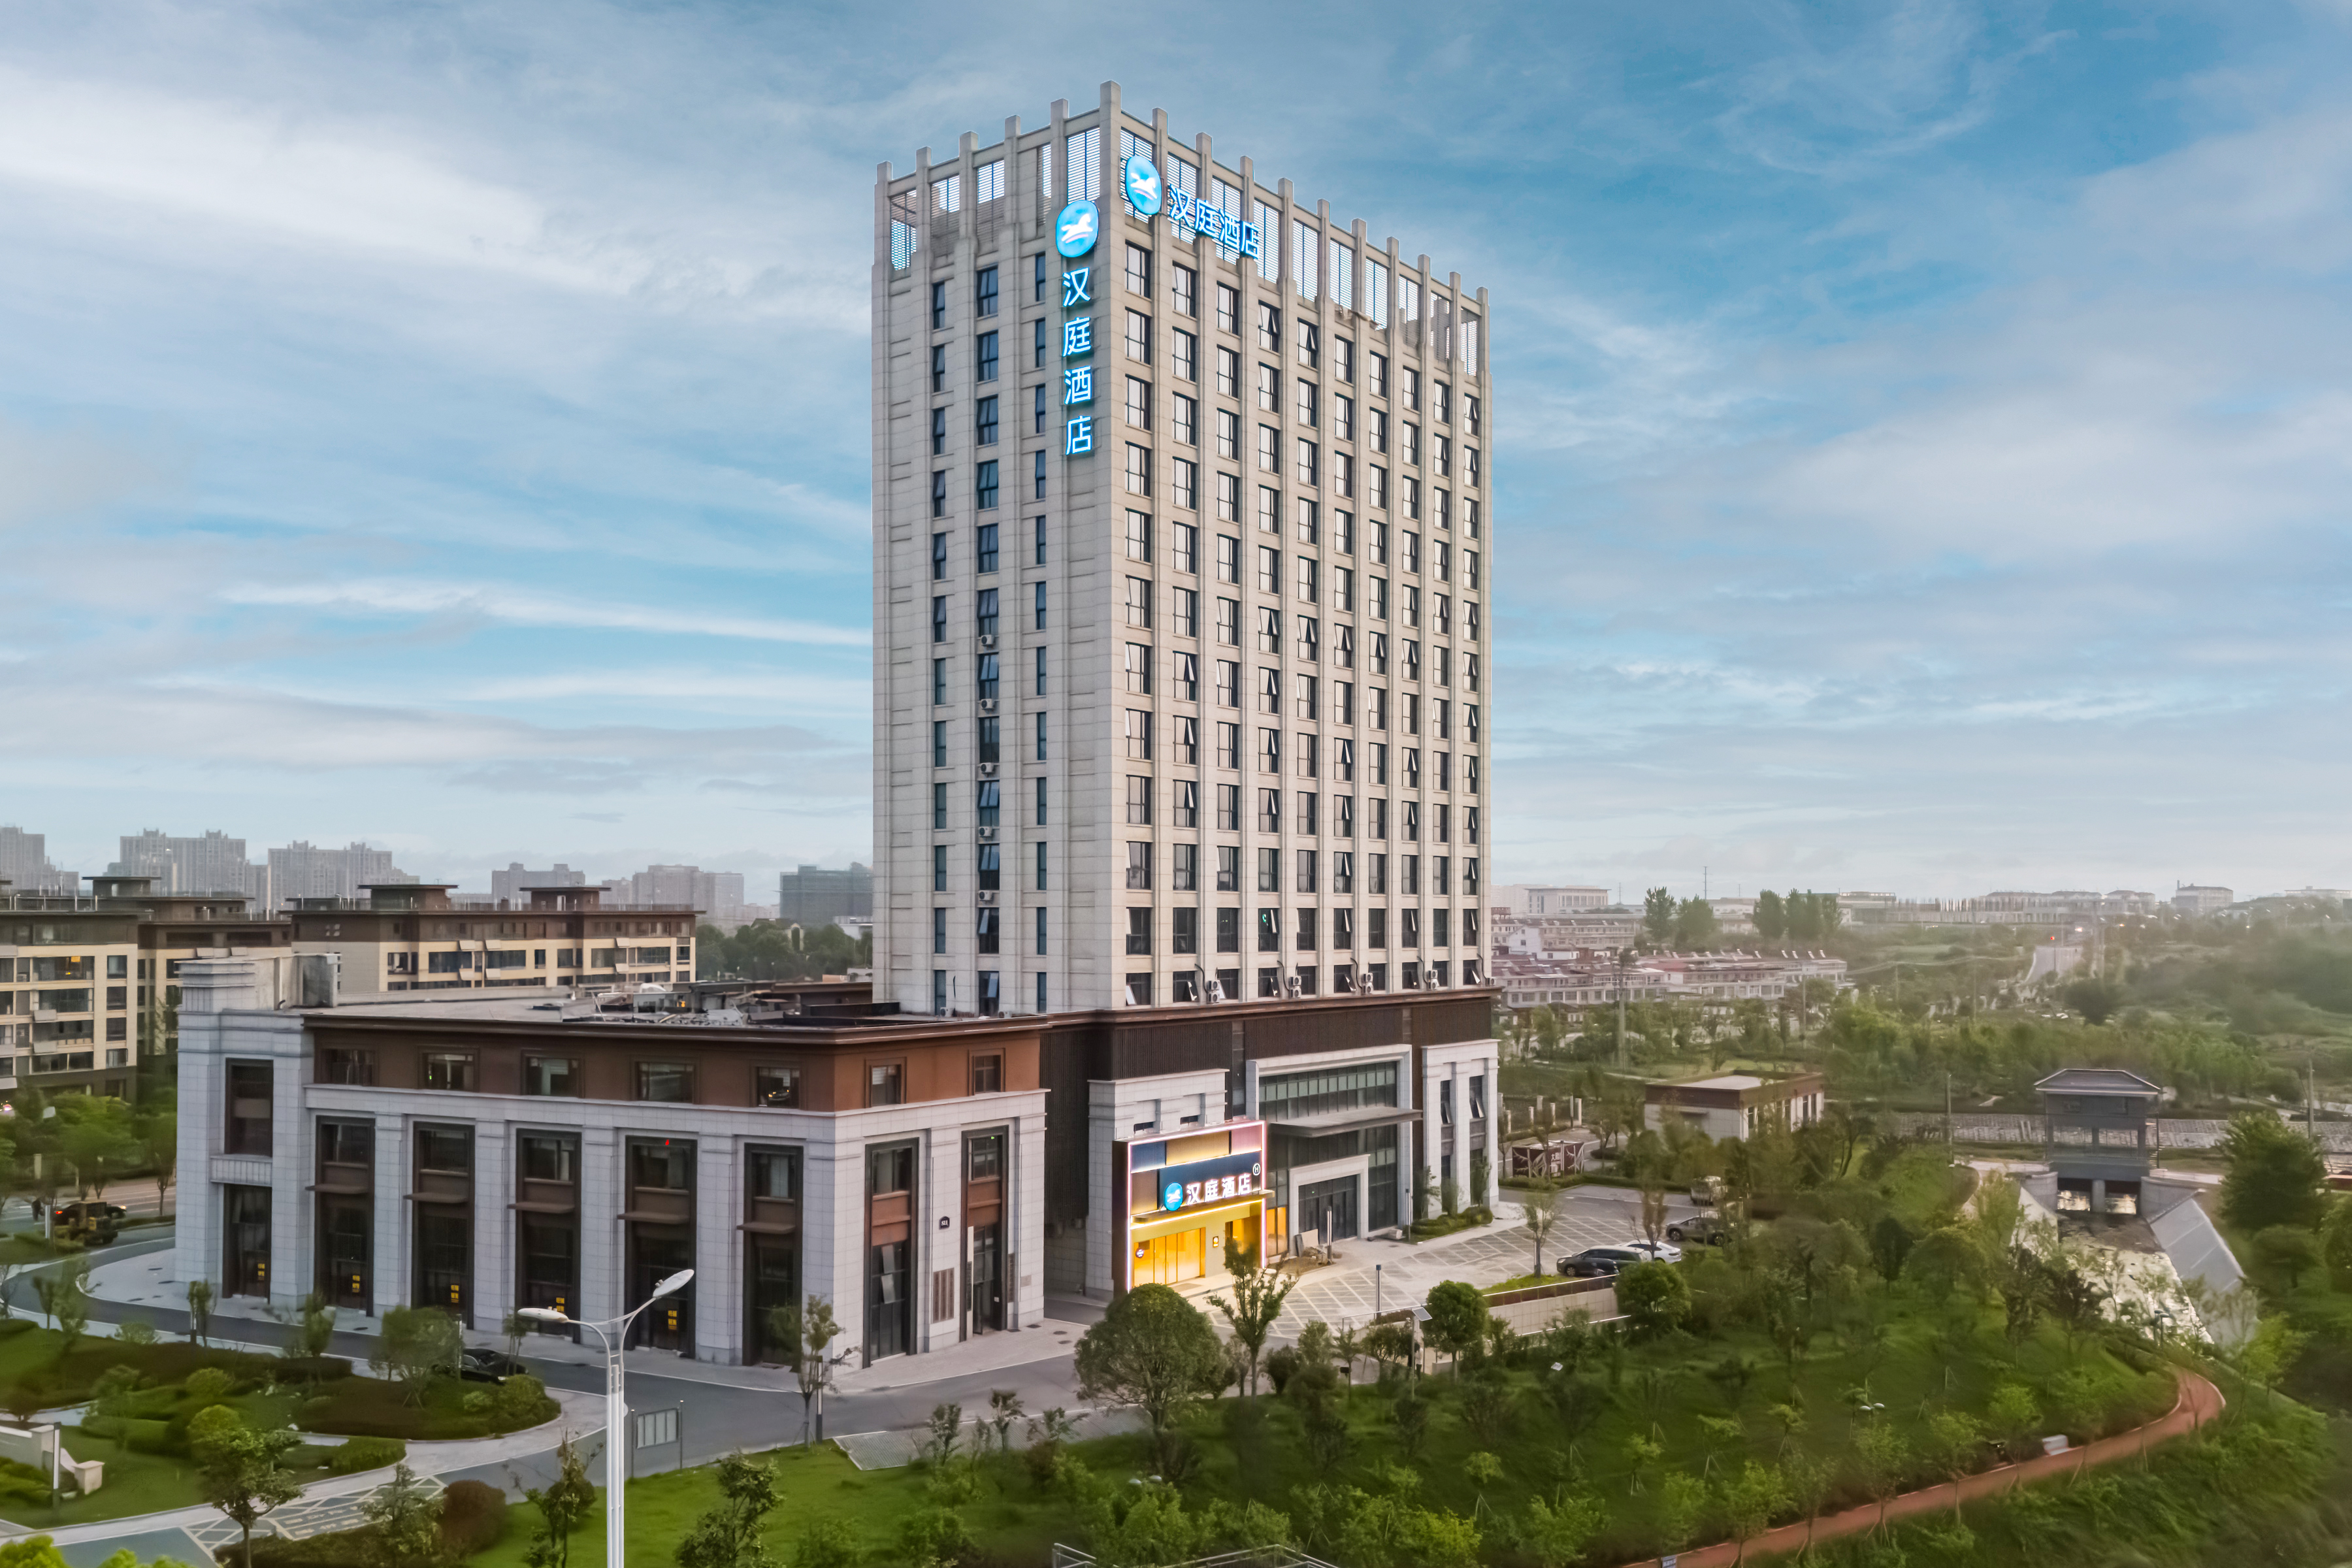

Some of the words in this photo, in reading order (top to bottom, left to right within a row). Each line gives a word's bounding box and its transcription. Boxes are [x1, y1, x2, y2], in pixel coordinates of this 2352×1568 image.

[1168, 184, 1260, 260] 汉庭酒店
[1062, 267, 1092, 455] 汉庭酒店
[1186, 1173, 1250, 1205] 汉庭酒店
